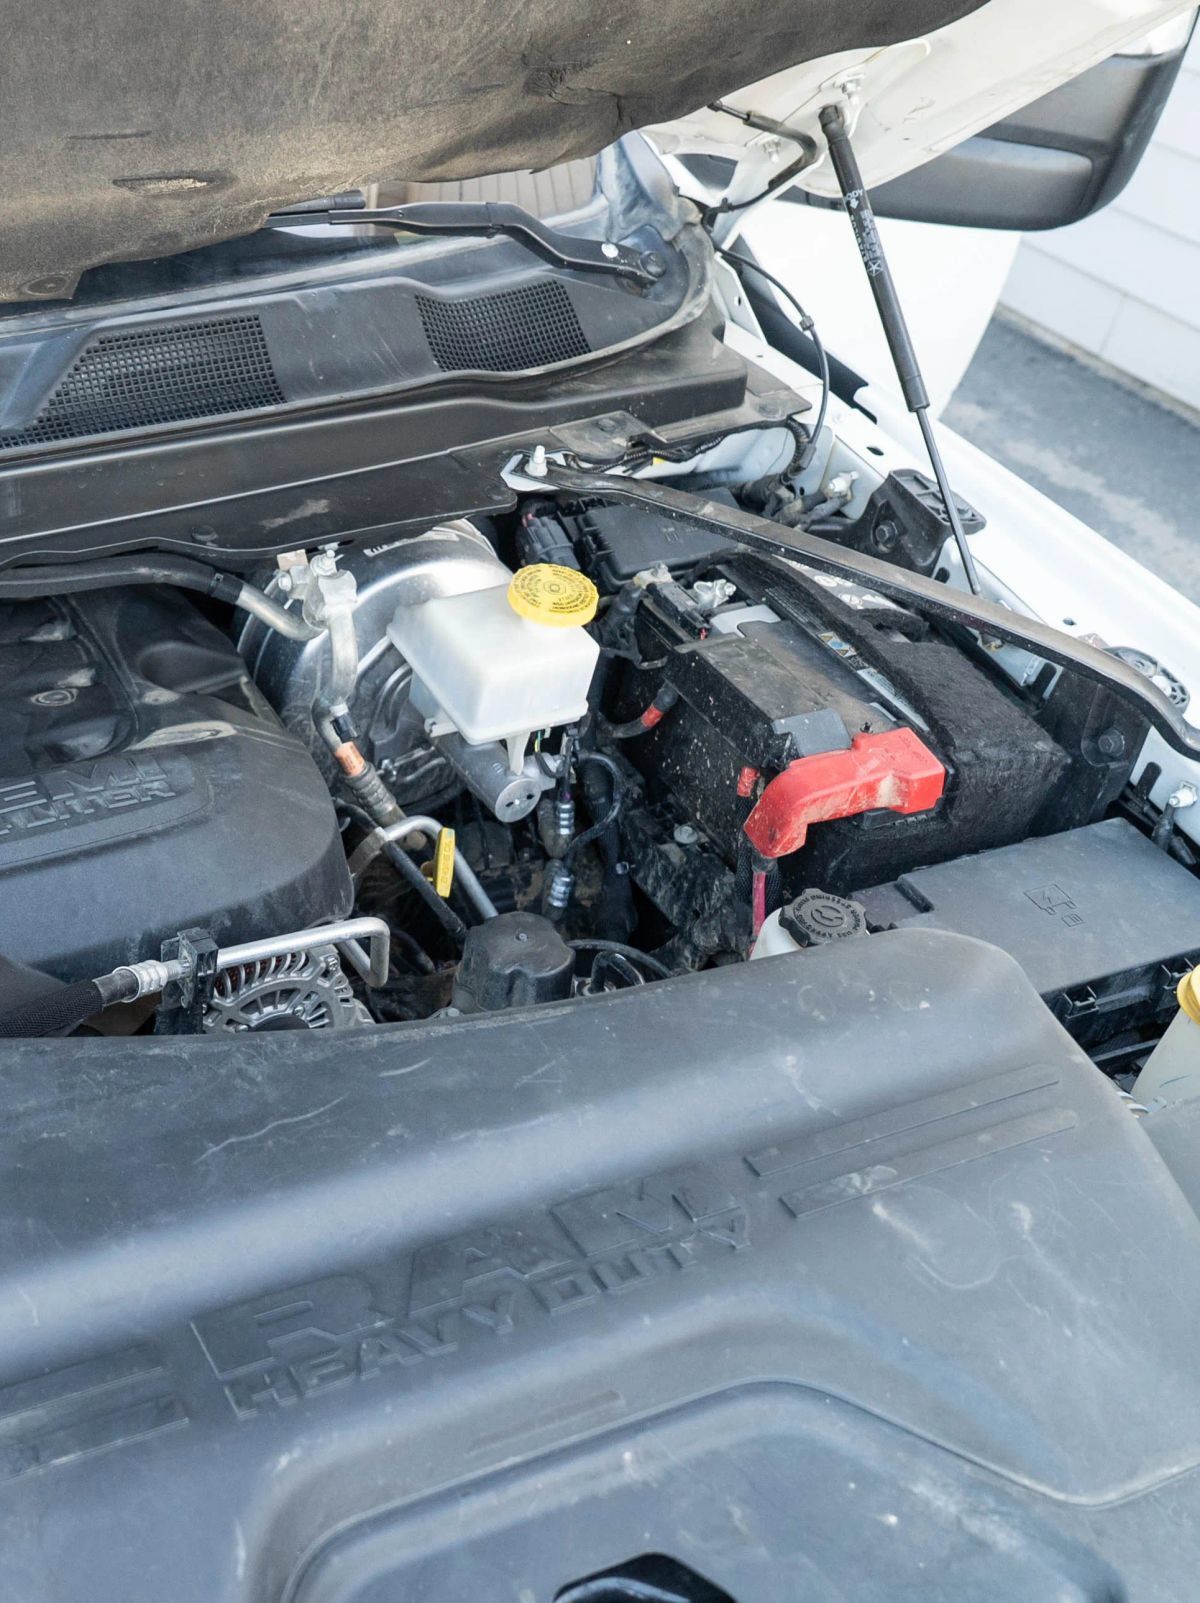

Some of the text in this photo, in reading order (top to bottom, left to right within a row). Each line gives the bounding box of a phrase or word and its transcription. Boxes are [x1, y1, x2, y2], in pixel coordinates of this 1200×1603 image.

[15, 781, 177, 828] LITER
[190, 1160, 741, 1380] RAM
[223, 1208, 751, 1420] HEAVY DUTY
